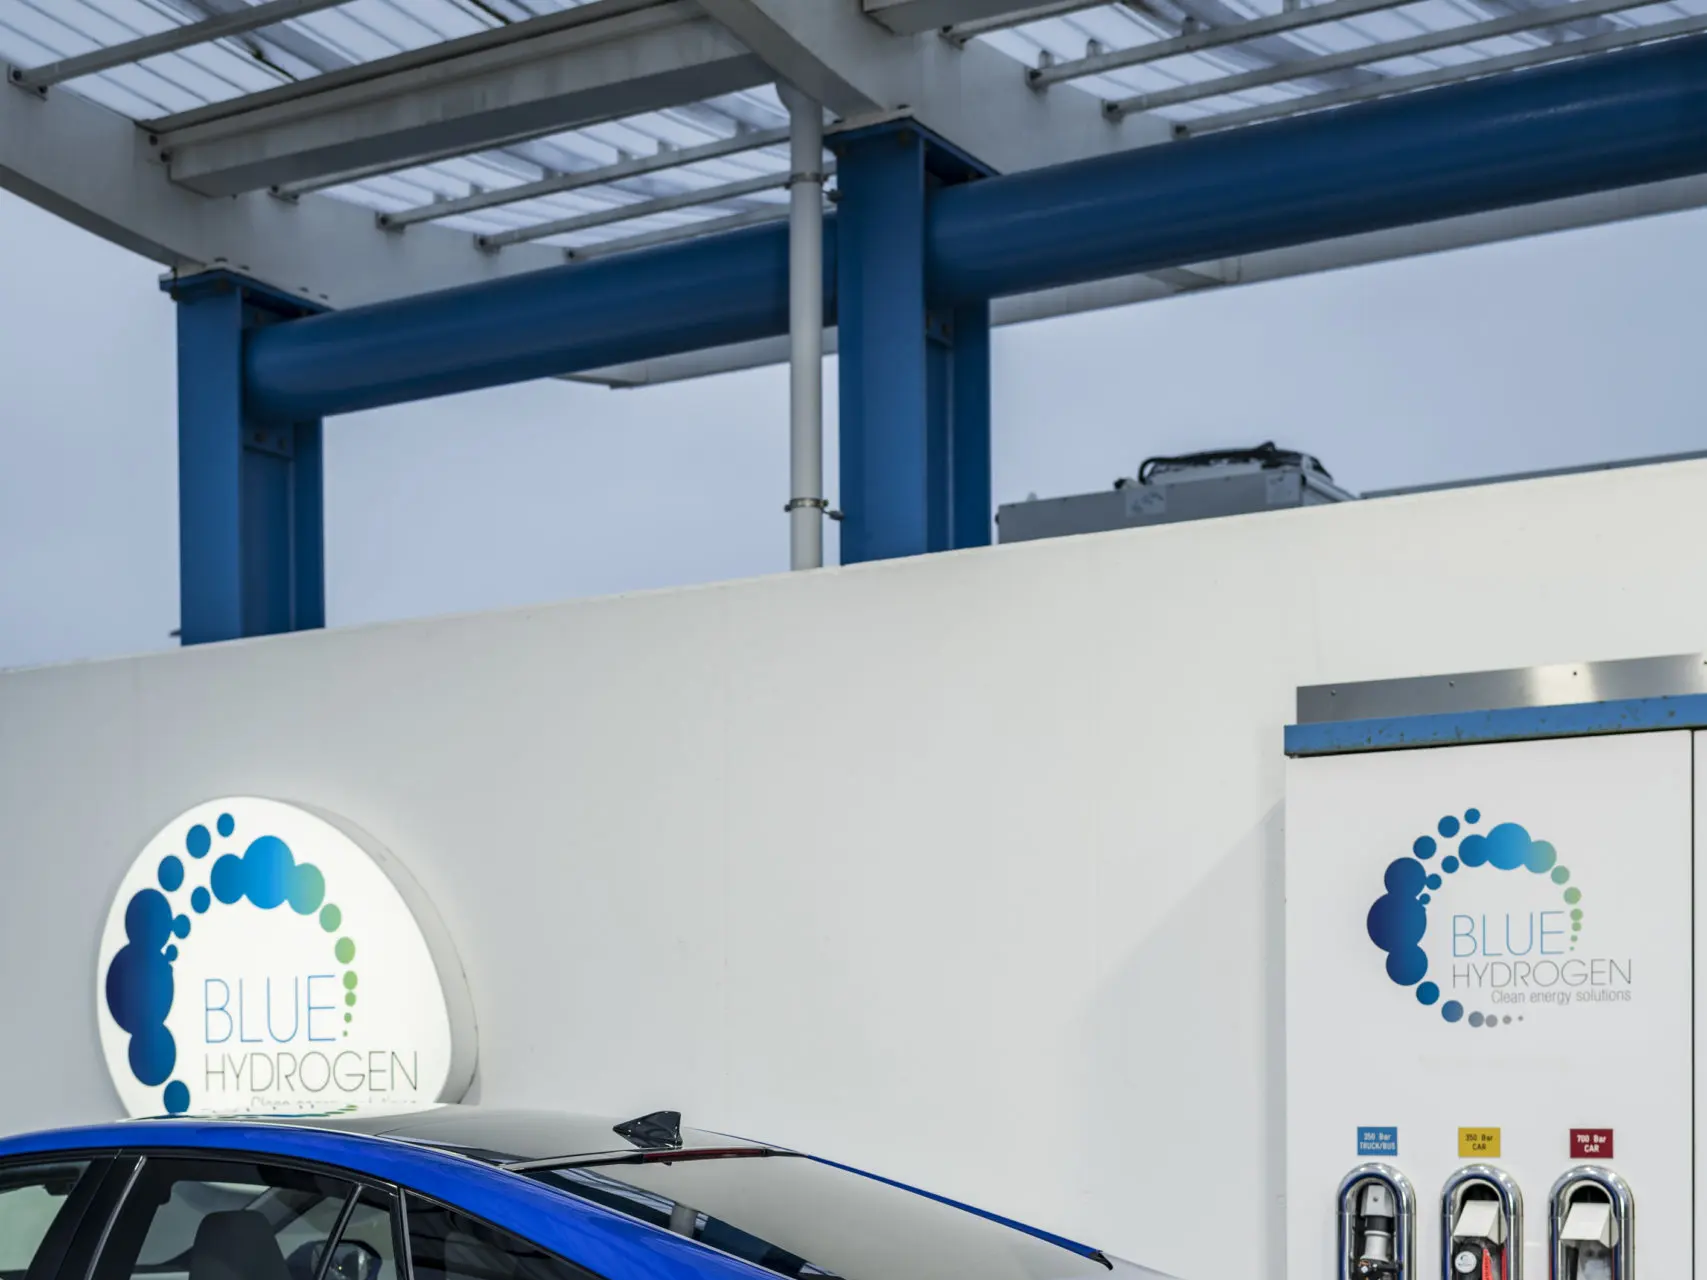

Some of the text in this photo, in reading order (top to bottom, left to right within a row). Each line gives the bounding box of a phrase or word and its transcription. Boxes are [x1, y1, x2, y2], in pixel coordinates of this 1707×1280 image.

[1453, 911, 1565, 957] BLUE
[1453, 959, 1632, 988] HYDROGEN
[1491, 988, 1632, 1006] Clean energy solutions
[204, 974, 336, 1044] BLUE
[205, 1050, 418, 1093] HYDROGEN
[1379, 1132, 1393, 1141] Bar
[1464, 1133, 1493, 1142] 350 Bar
[1576, 1134, 1606, 1143] 700 Bar
[1359, 1141, 1396, 1150] TRUCK/BUS
[1472, 1142, 1487, 1151] CAR
[1583, 1143, 1600, 1153] CAR
